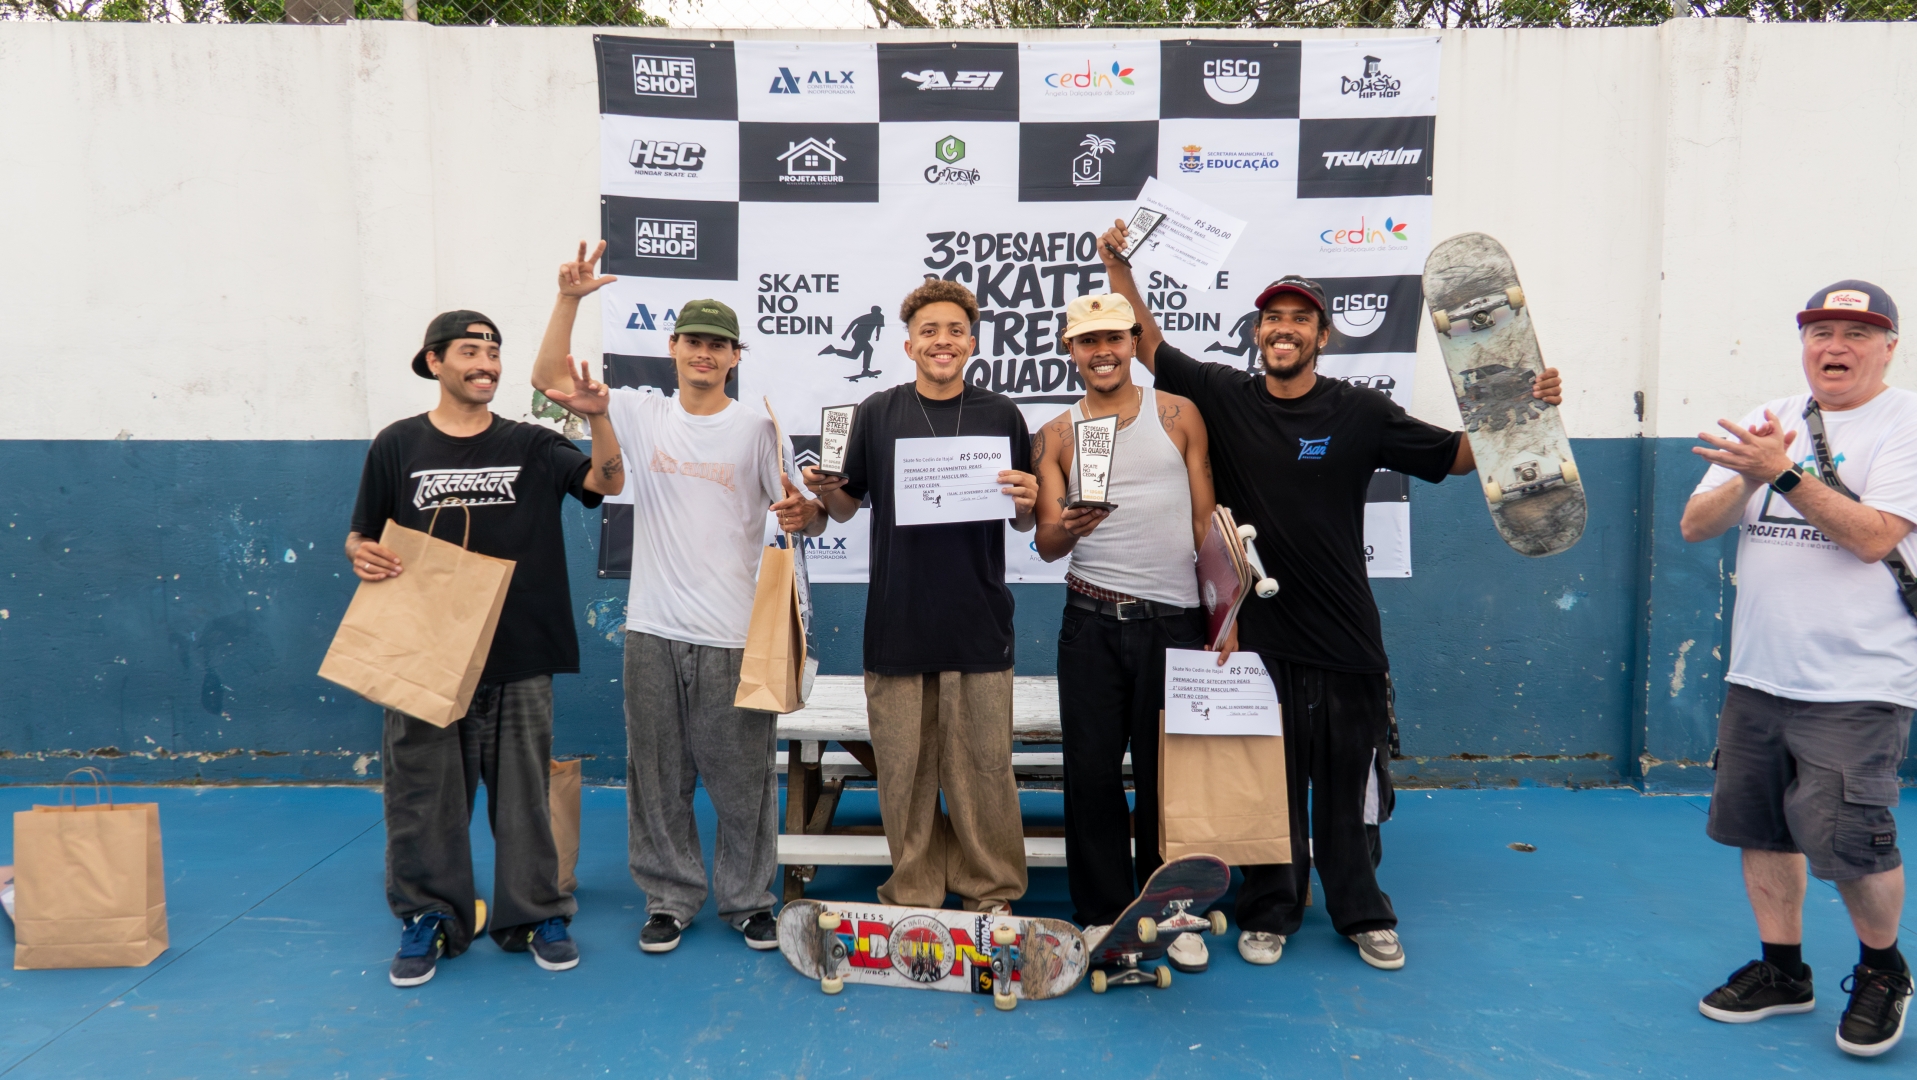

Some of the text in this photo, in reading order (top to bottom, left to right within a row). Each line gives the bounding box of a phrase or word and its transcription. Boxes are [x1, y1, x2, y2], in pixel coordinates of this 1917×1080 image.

[635, 58, 694, 78] ALIFE
[807, 70, 854, 83] ALX
[1044, 59, 1112, 89] cedin
[637, 75, 694, 93] SHOP
[629, 139, 706, 171] HSC
[1206, 157, 1279, 171] EDUCAÇÃO
[638, 222, 695, 240] ALIFE
[1194, 219, 1231, 240] R$ 300,00
[1320, 216, 1386, 244] cedin
[638, 239, 695, 255] SHOP
[972, 231, 1097, 263] DESAFIO
[758, 274, 839, 293] SKATE
[758, 295, 798, 313] NO
[1147, 291, 1187, 310] NO
[757, 316, 833, 335] CEDIN
[1082, 439, 1111, 448] STREET
[1085, 431, 1110, 440] SKATE
[960, 452, 1001, 461] R$ 500,00
[1813, 433, 1840, 487] NIKE
[410, 466, 522, 508] THRASHER
[1746, 524, 1797, 539] PROJETA
[1230, 667, 1241, 675] R$
